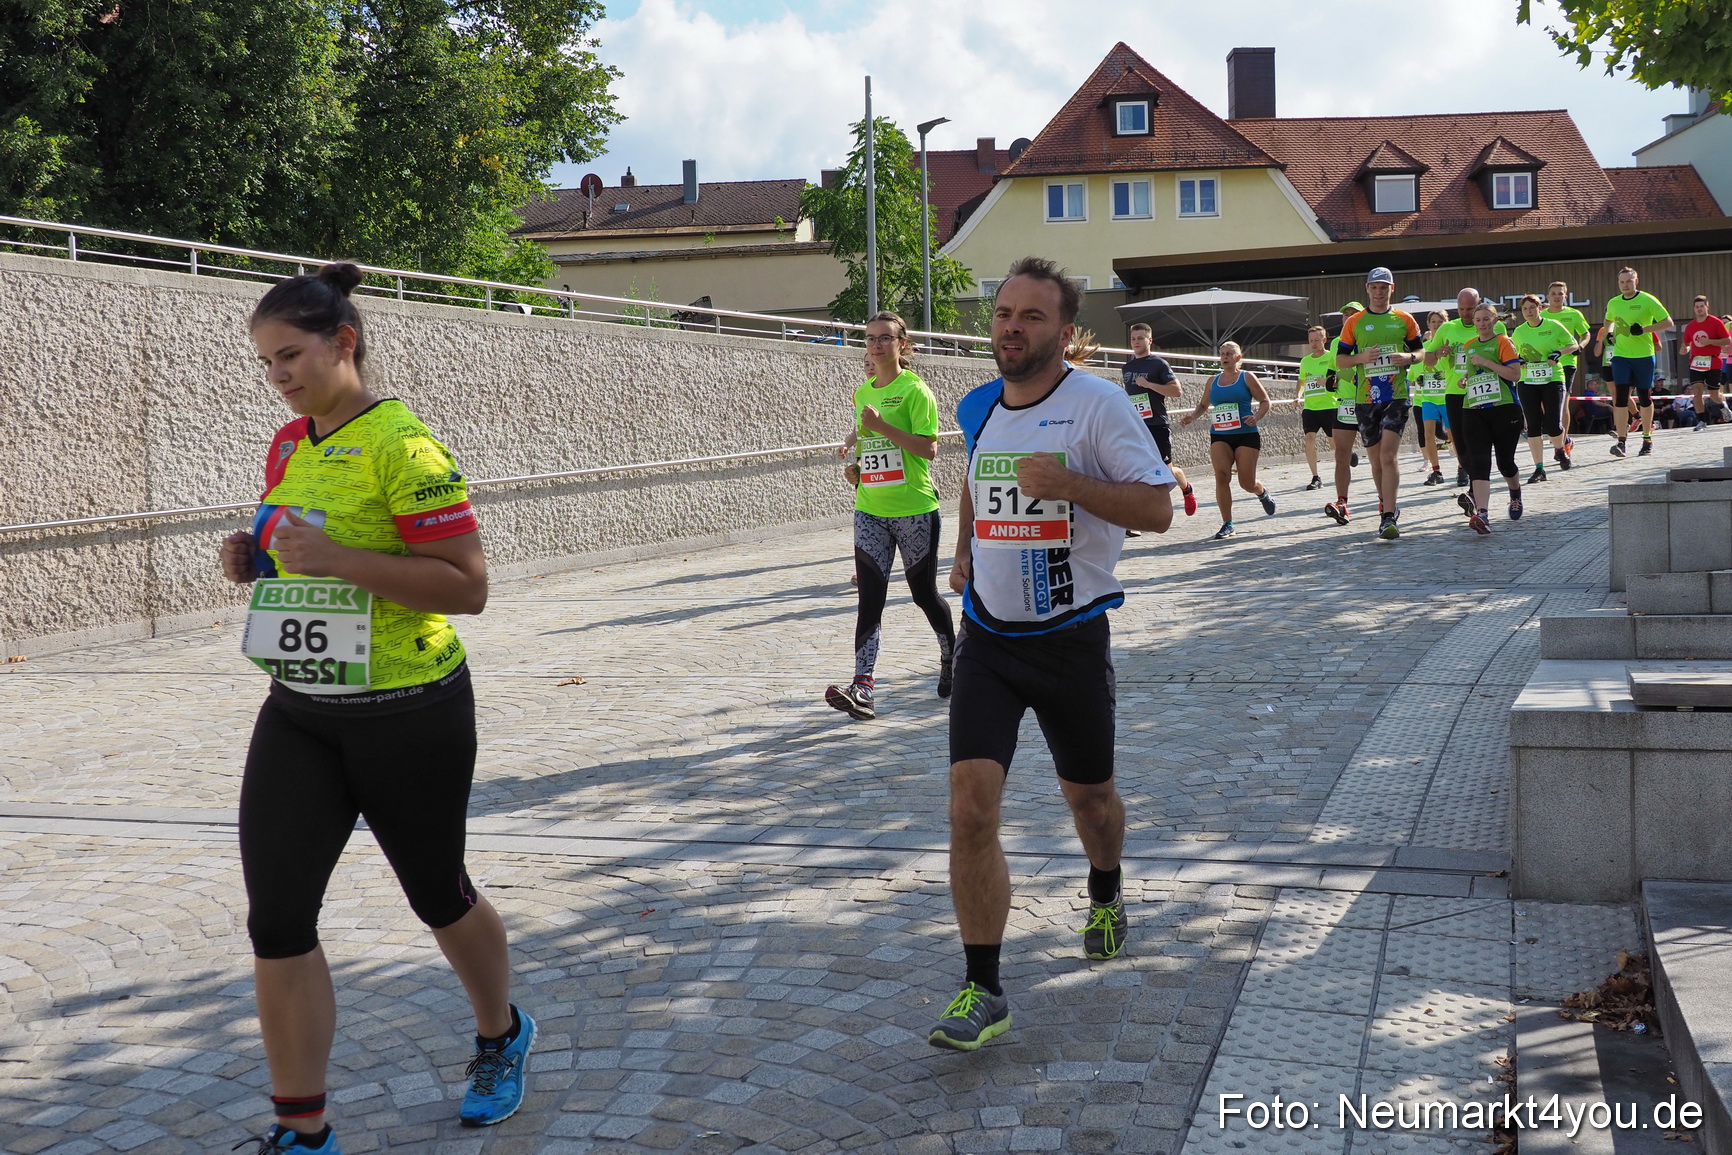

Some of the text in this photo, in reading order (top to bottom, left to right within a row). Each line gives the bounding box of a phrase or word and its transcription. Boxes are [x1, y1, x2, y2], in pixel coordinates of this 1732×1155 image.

[1531, 369, 1547, 377] 153
[1428, 380, 1442, 389] 155
[1472, 383, 1492, 396] 112
[1134, 402, 1145, 412] 15
[1344, 407, 1354, 415] 15
[1216, 412, 1233, 423] 513
[864, 453, 889, 470] 531
[870, 473, 885, 482] EVA
[415, 485, 456, 502] BMW
[988, 486, 1044, 515] 512
[989, 524, 1041, 538] ANDRE
[1034, 551, 1048, 609] NOLOGY
[260, 585, 358, 609] BOCK
[1022, 577, 1032, 612] Solutions
[278, 618, 329, 654] 86
[263, 657, 347, 686] JESSI
[310, 685, 424, 705] www.bmw-partl.de
